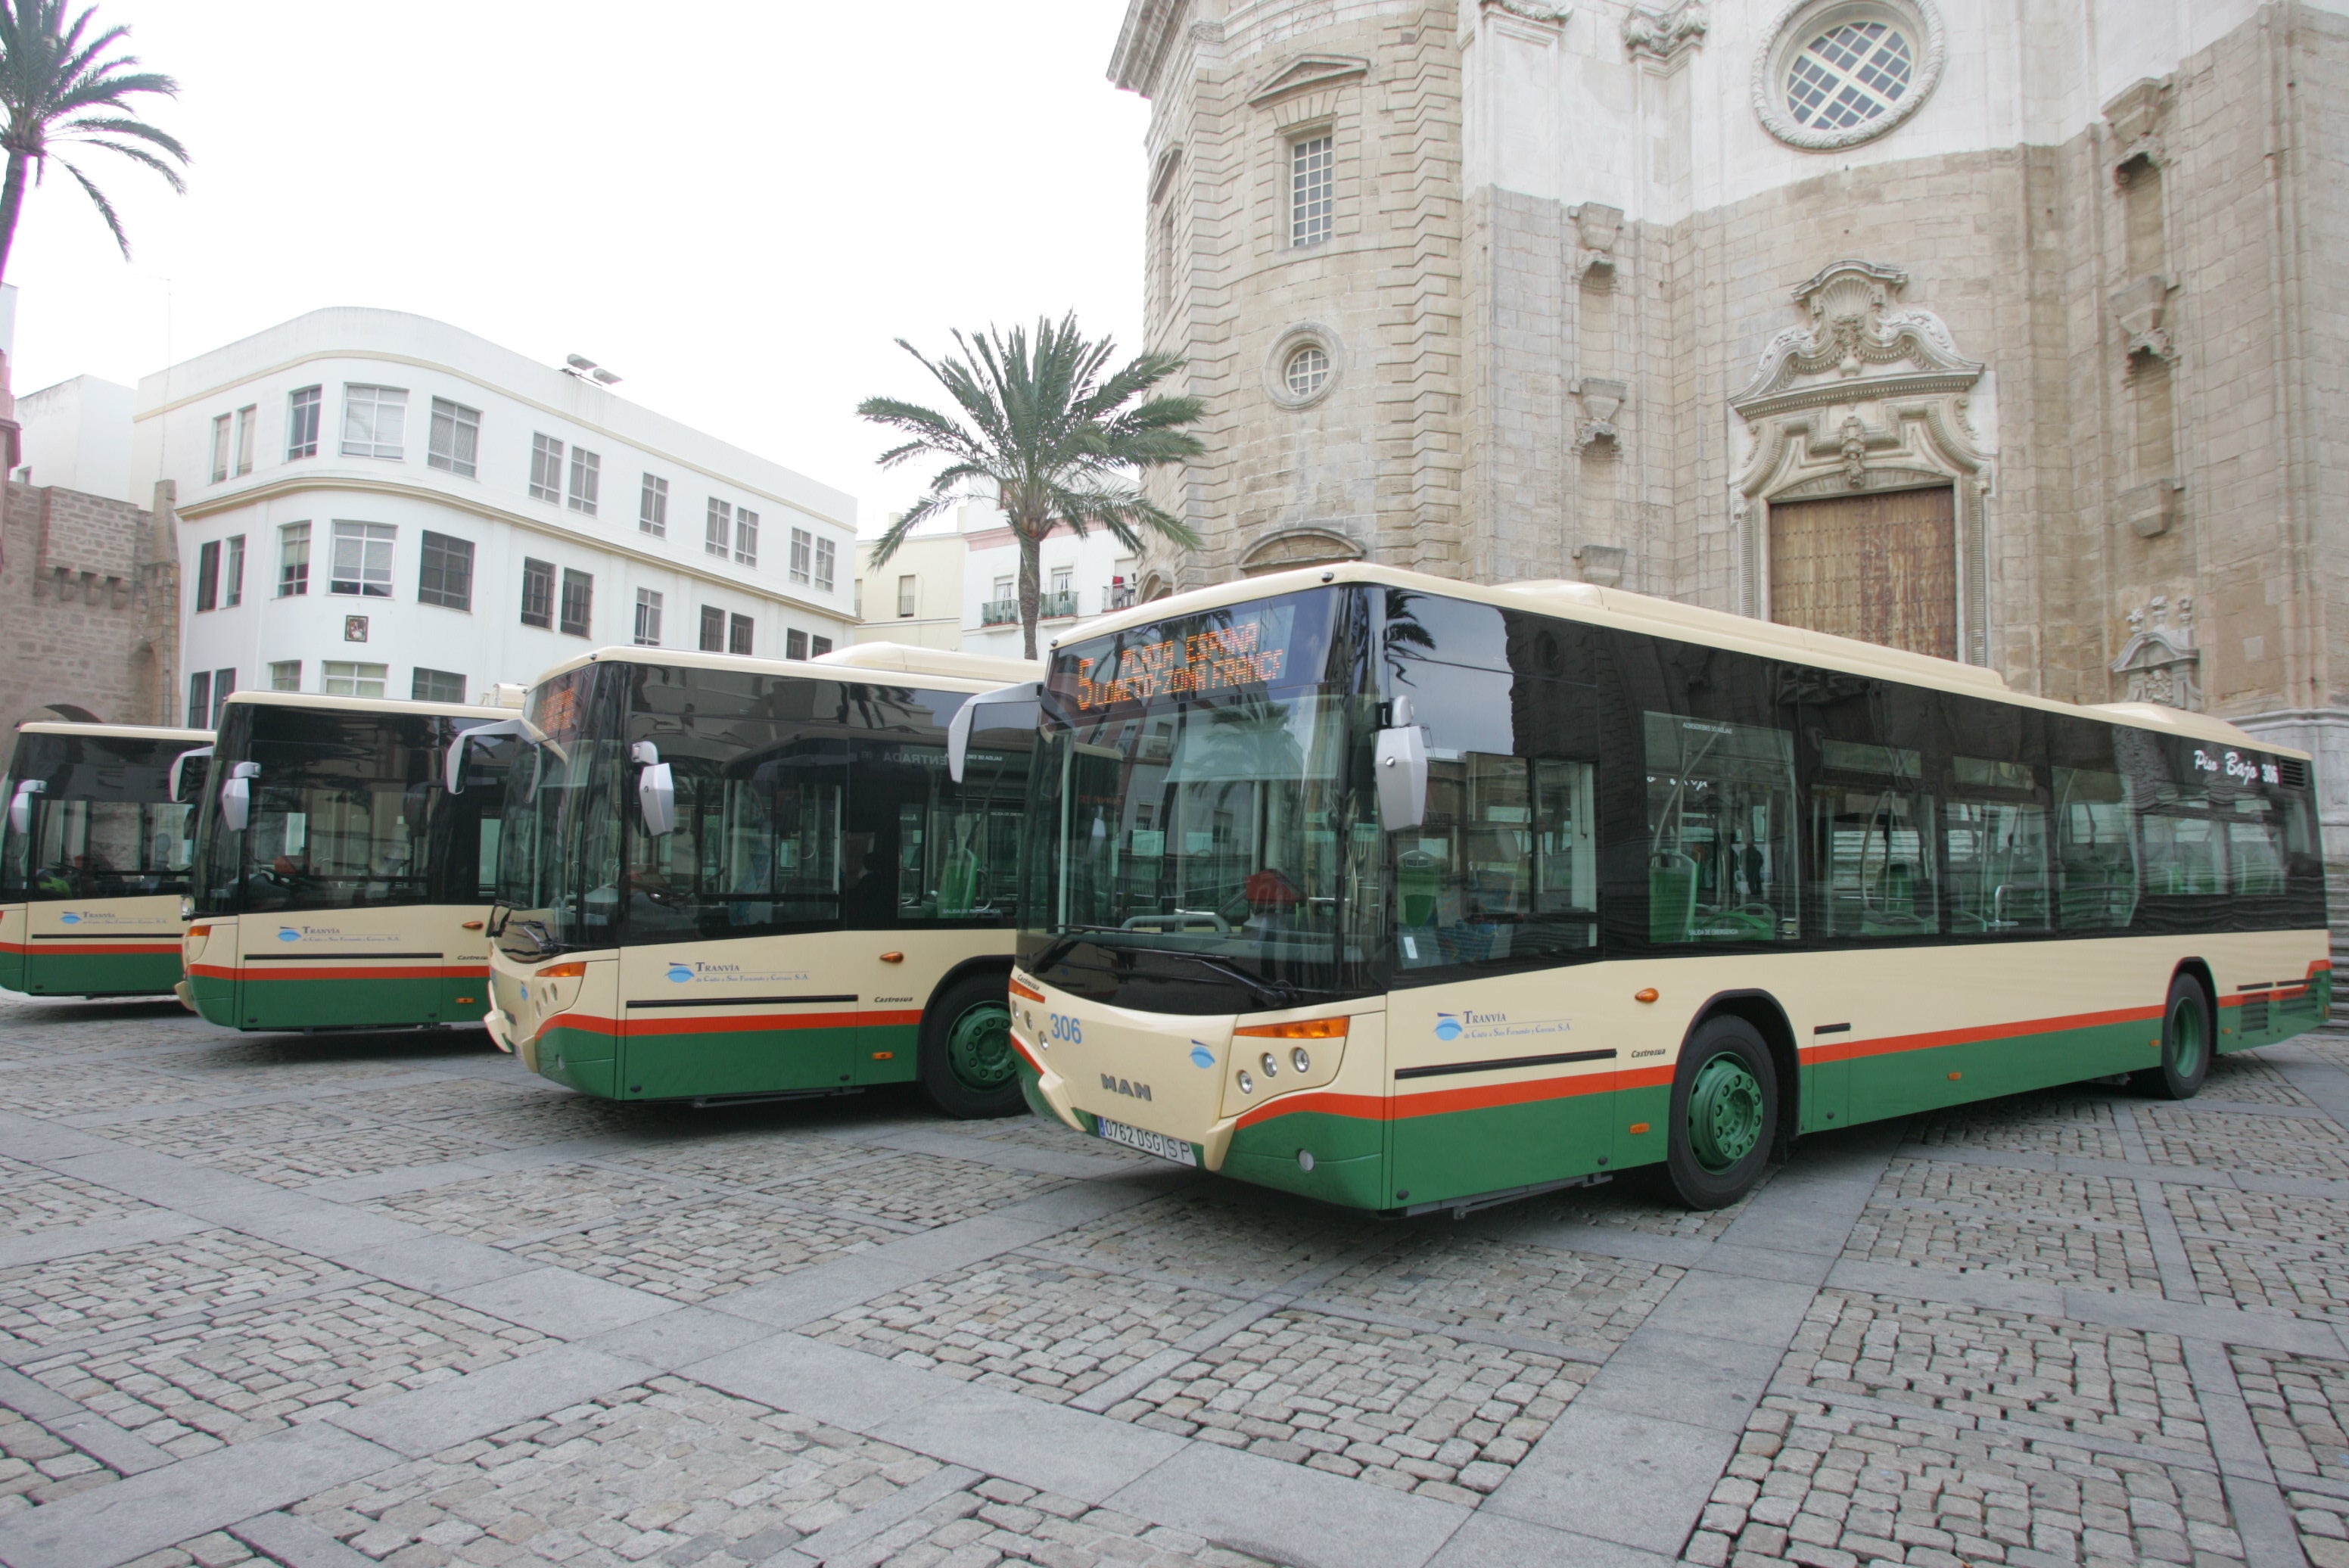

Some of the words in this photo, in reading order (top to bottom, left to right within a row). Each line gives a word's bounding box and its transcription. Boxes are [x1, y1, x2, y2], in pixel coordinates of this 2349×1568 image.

[1122, 639, 1174, 676] PLAZA
[1078, 657, 1095, 711] 5
[2194, 749, 2220, 771] Piso
[2225, 751, 2258, 786] Bajo
[1050, 1013, 1082, 1044] 306
[1631, 1049, 1666, 1058] Castrosua
[1100, 1072, 1153, 1102] MAN
[1105, 1120, 1134, 1144] 0762
[1137, 1129, 1161, 1152] DSG
